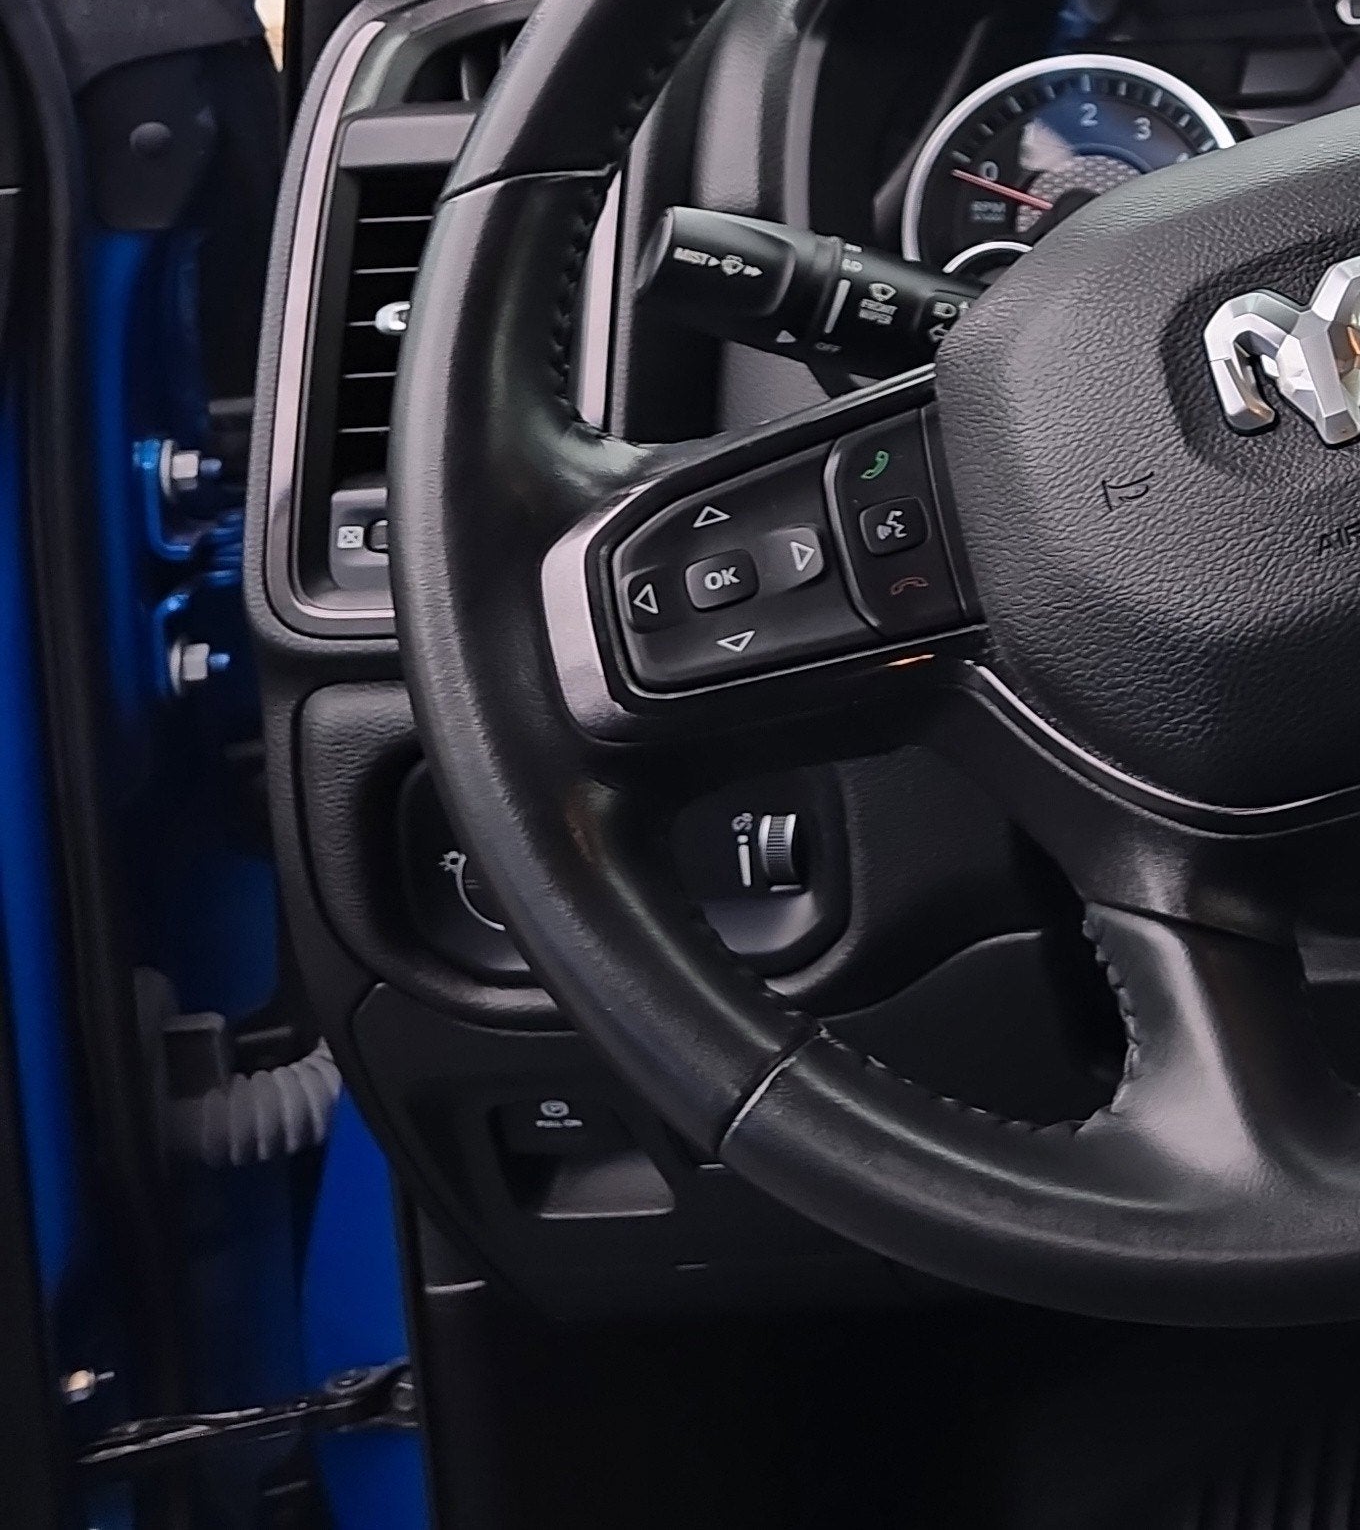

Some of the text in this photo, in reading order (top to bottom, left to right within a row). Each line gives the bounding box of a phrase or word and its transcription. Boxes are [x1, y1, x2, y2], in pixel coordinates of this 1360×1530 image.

[1080, 103, 1098, 127] 2
[1135, 118, 1152, 141] 3
[980, 161, 999, 181] 0
[704, 567, 740, 590] OK
